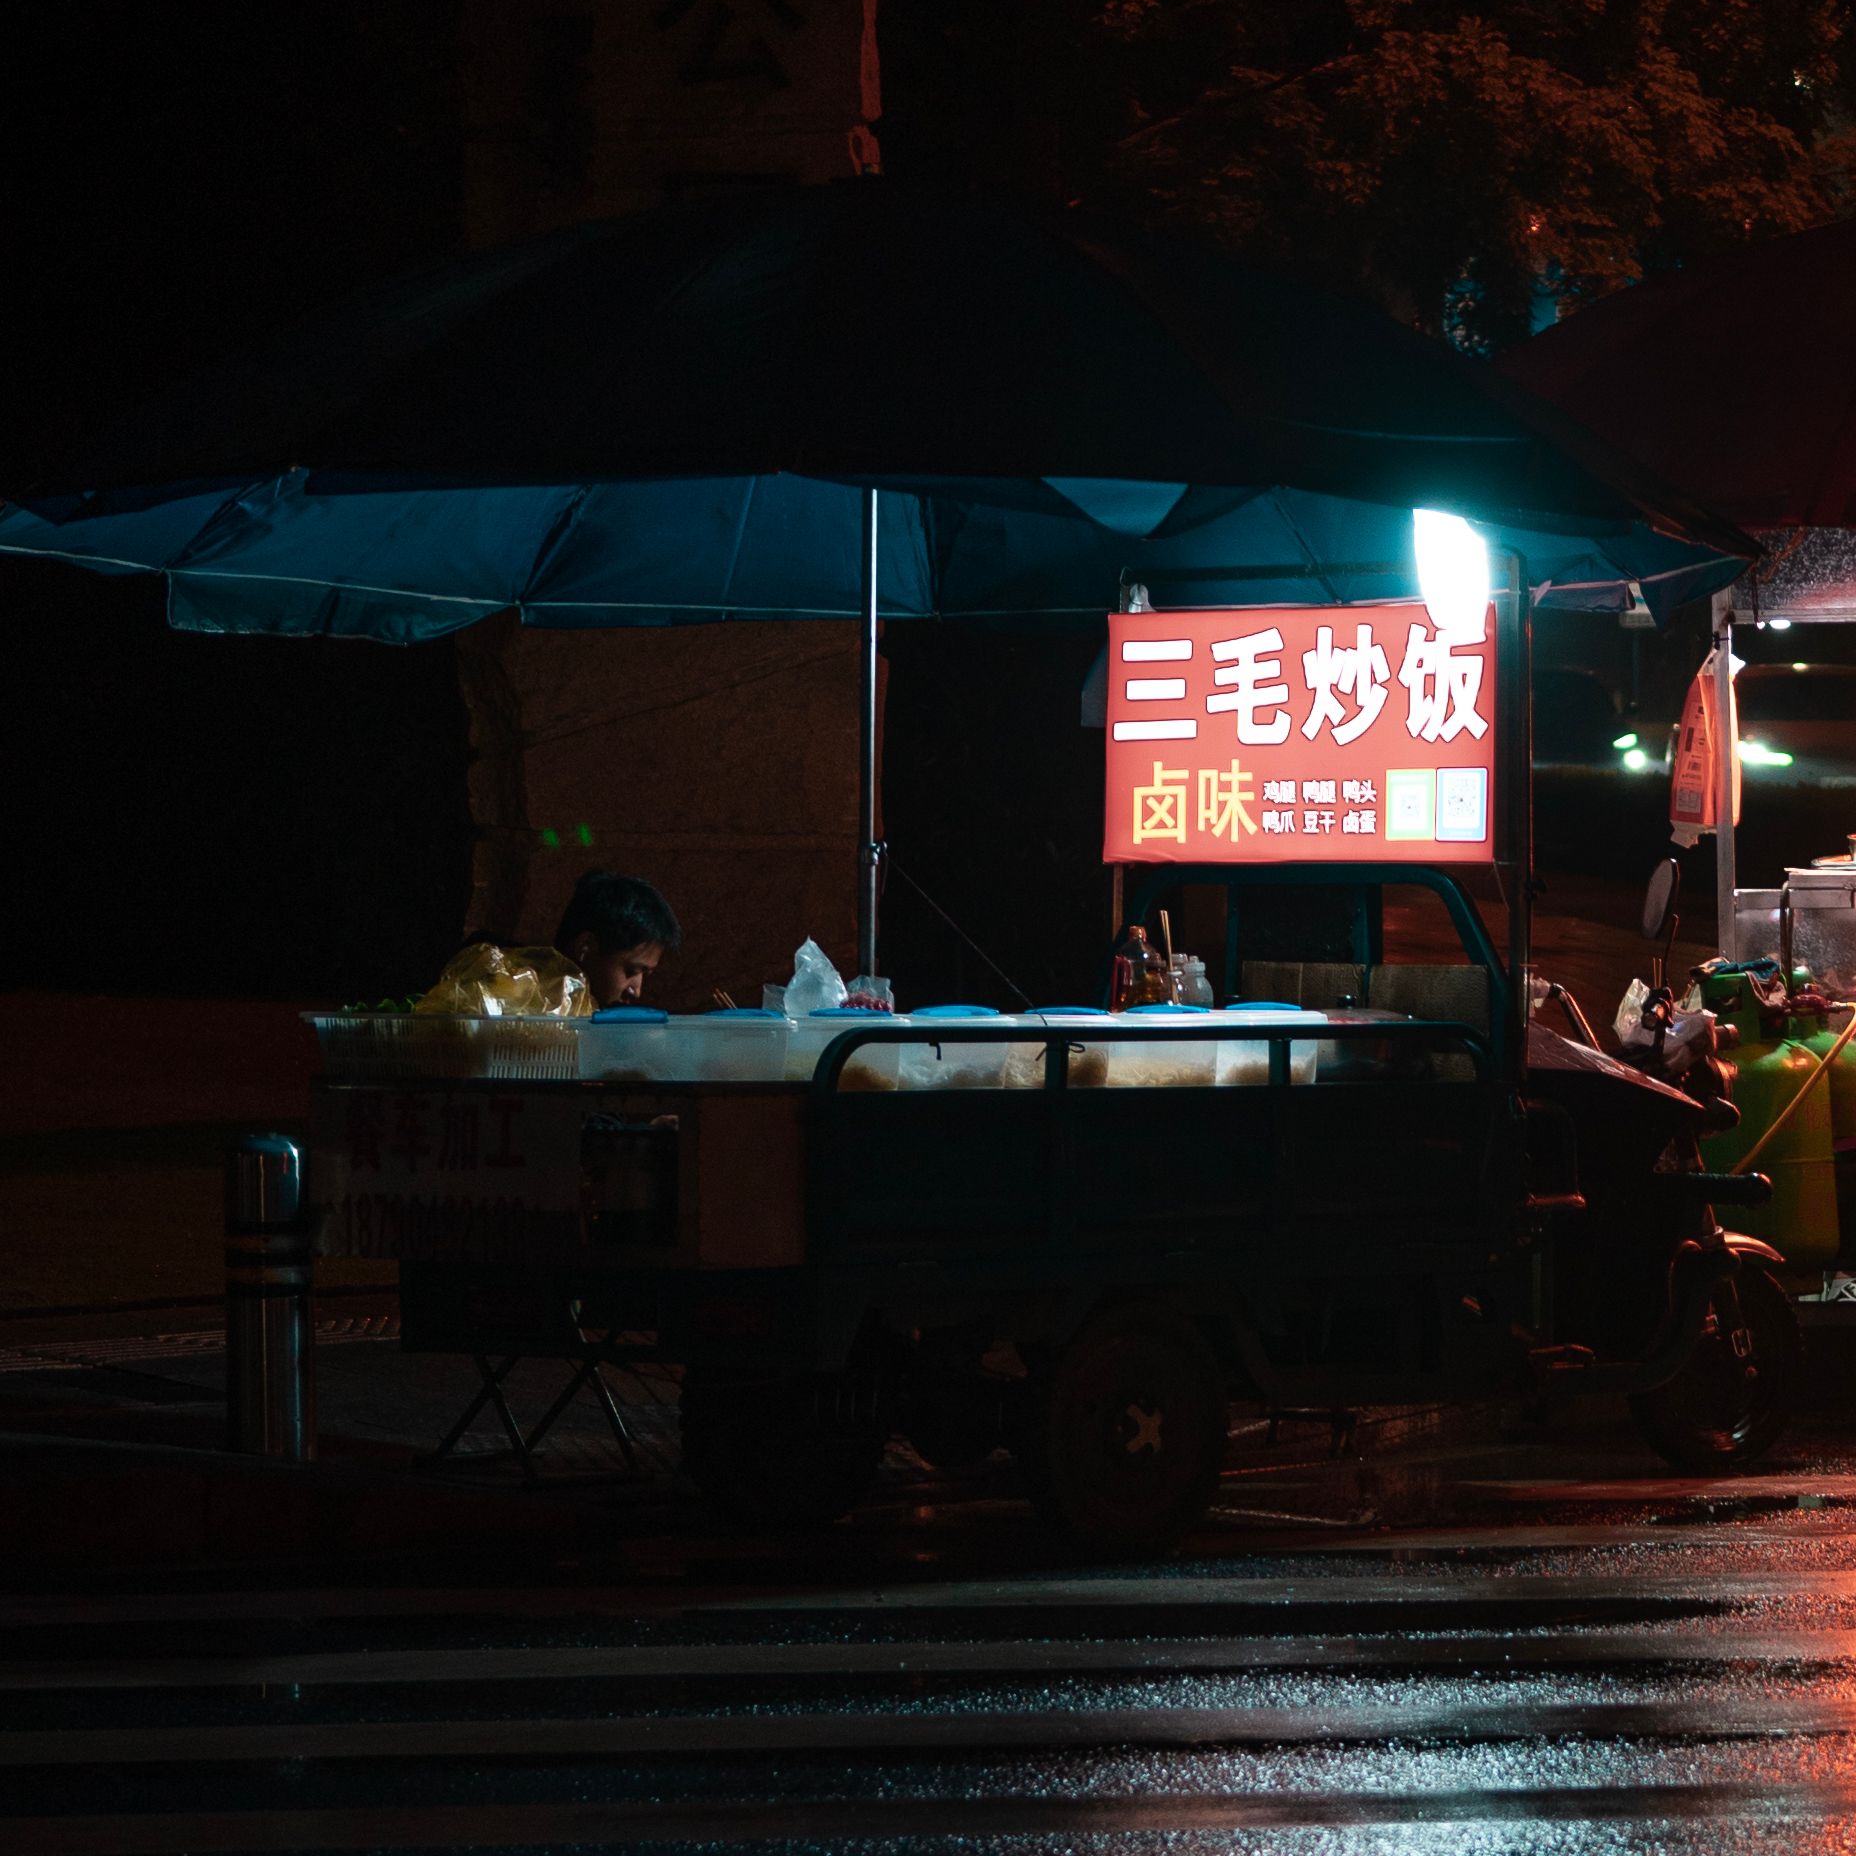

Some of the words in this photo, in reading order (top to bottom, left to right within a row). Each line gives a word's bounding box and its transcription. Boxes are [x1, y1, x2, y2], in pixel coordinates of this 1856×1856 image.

[1112, 623, 1490, 746] 三毛炒饭
[1133, 759, 1257, 845] 卤味
[1262, 779, 1297, 804] 鸡腿
[1302, 779, 1337, 804] 鸭腿
[1342, 779, 1377, 804] 鸭头
[1262, 809, 1296, 834] 鸭爪
[1302, 810, 1336, 834] 豆干
[1342, 809, 1377, 834] 卤蛋
